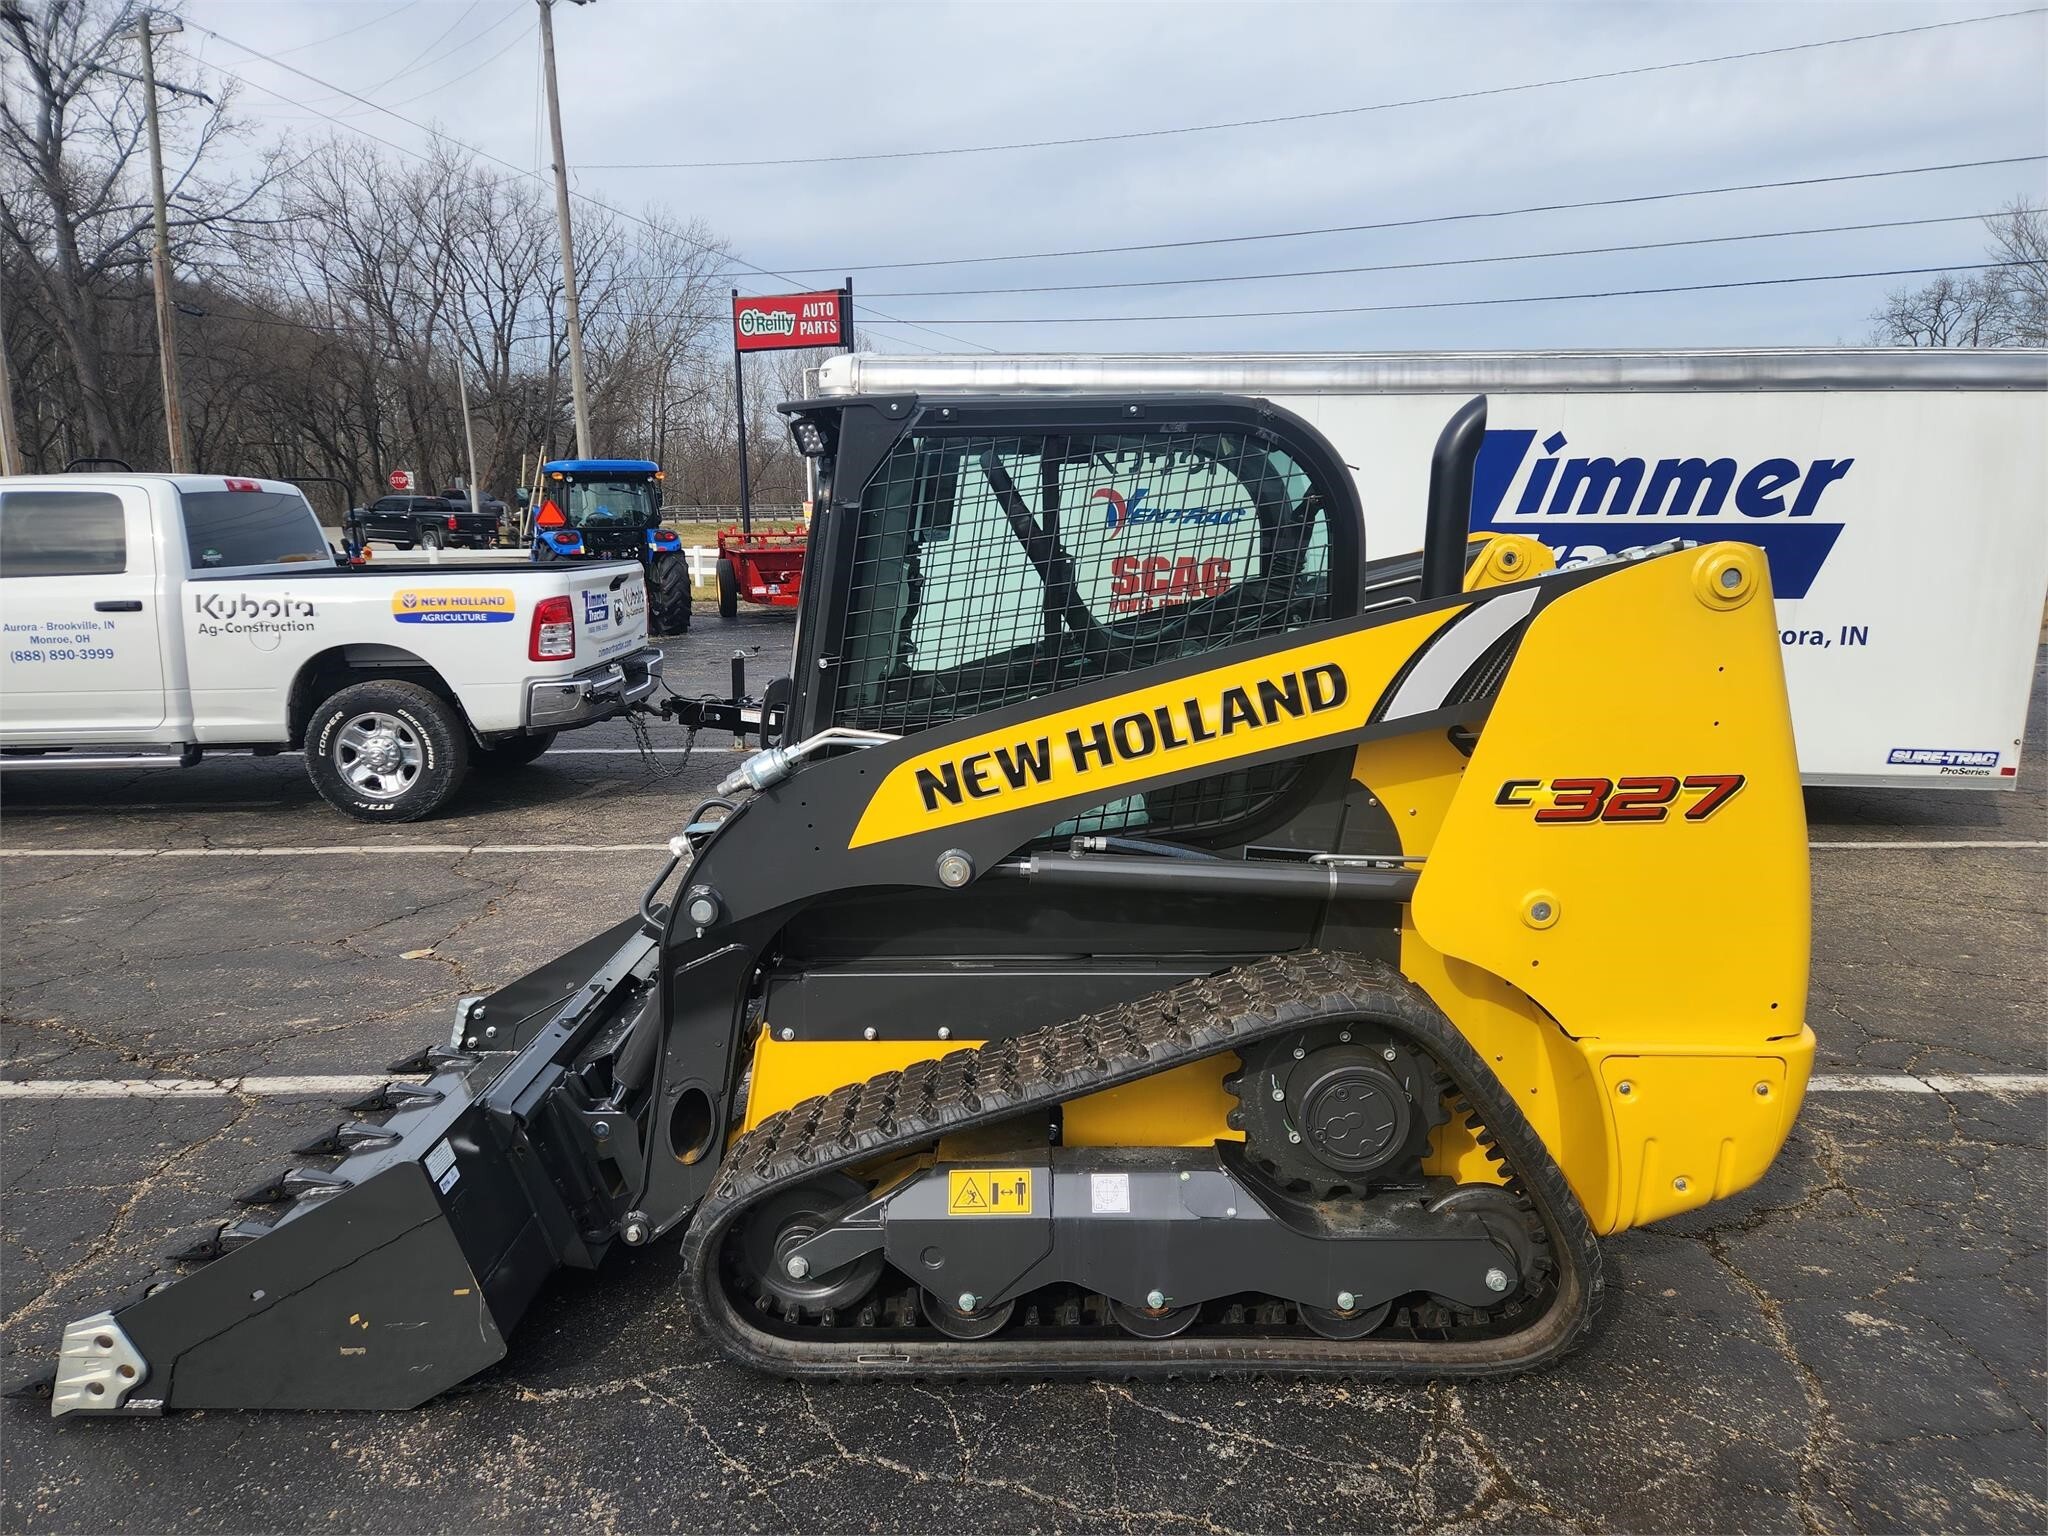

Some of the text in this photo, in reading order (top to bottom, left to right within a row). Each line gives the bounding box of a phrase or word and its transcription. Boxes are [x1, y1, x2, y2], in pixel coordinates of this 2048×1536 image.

[803, 302, 834, 317] AUTO
[740, 309, 795, 335] O'Reilly
[800, 320, 837, 335] PARTS
[391, 476, 408, 484] STOP
[1111, 556, 1232, 597] SCAG
[195, 591, 316, 619] Kubota
[421, 596, 505, 606] NEW HOLLAND
[420, 613, 488, 622] AGRICULTURE
[3, 623, 38, 632] Aurora
[46, 621, 101, 631] Brookville,
[104, 620, 115, 629] IN
[198, 620, 315, 637] Ag-Construction
[30, 634, 91, 644] Monroe, OH
[1779, 626, 1868, 649] ora, IN
[10, 648, 114, 663] (888) 890-3999
[318, 711, 344, 757] COOPER
[397, 708, 434, 770] DISCOVERER
[914, 662, 1350, 813] NEW HOLLAND
[1890, 750, 1997, 766] SURE-TRAC
[1940, 767, 1990, 776] ProSeries
